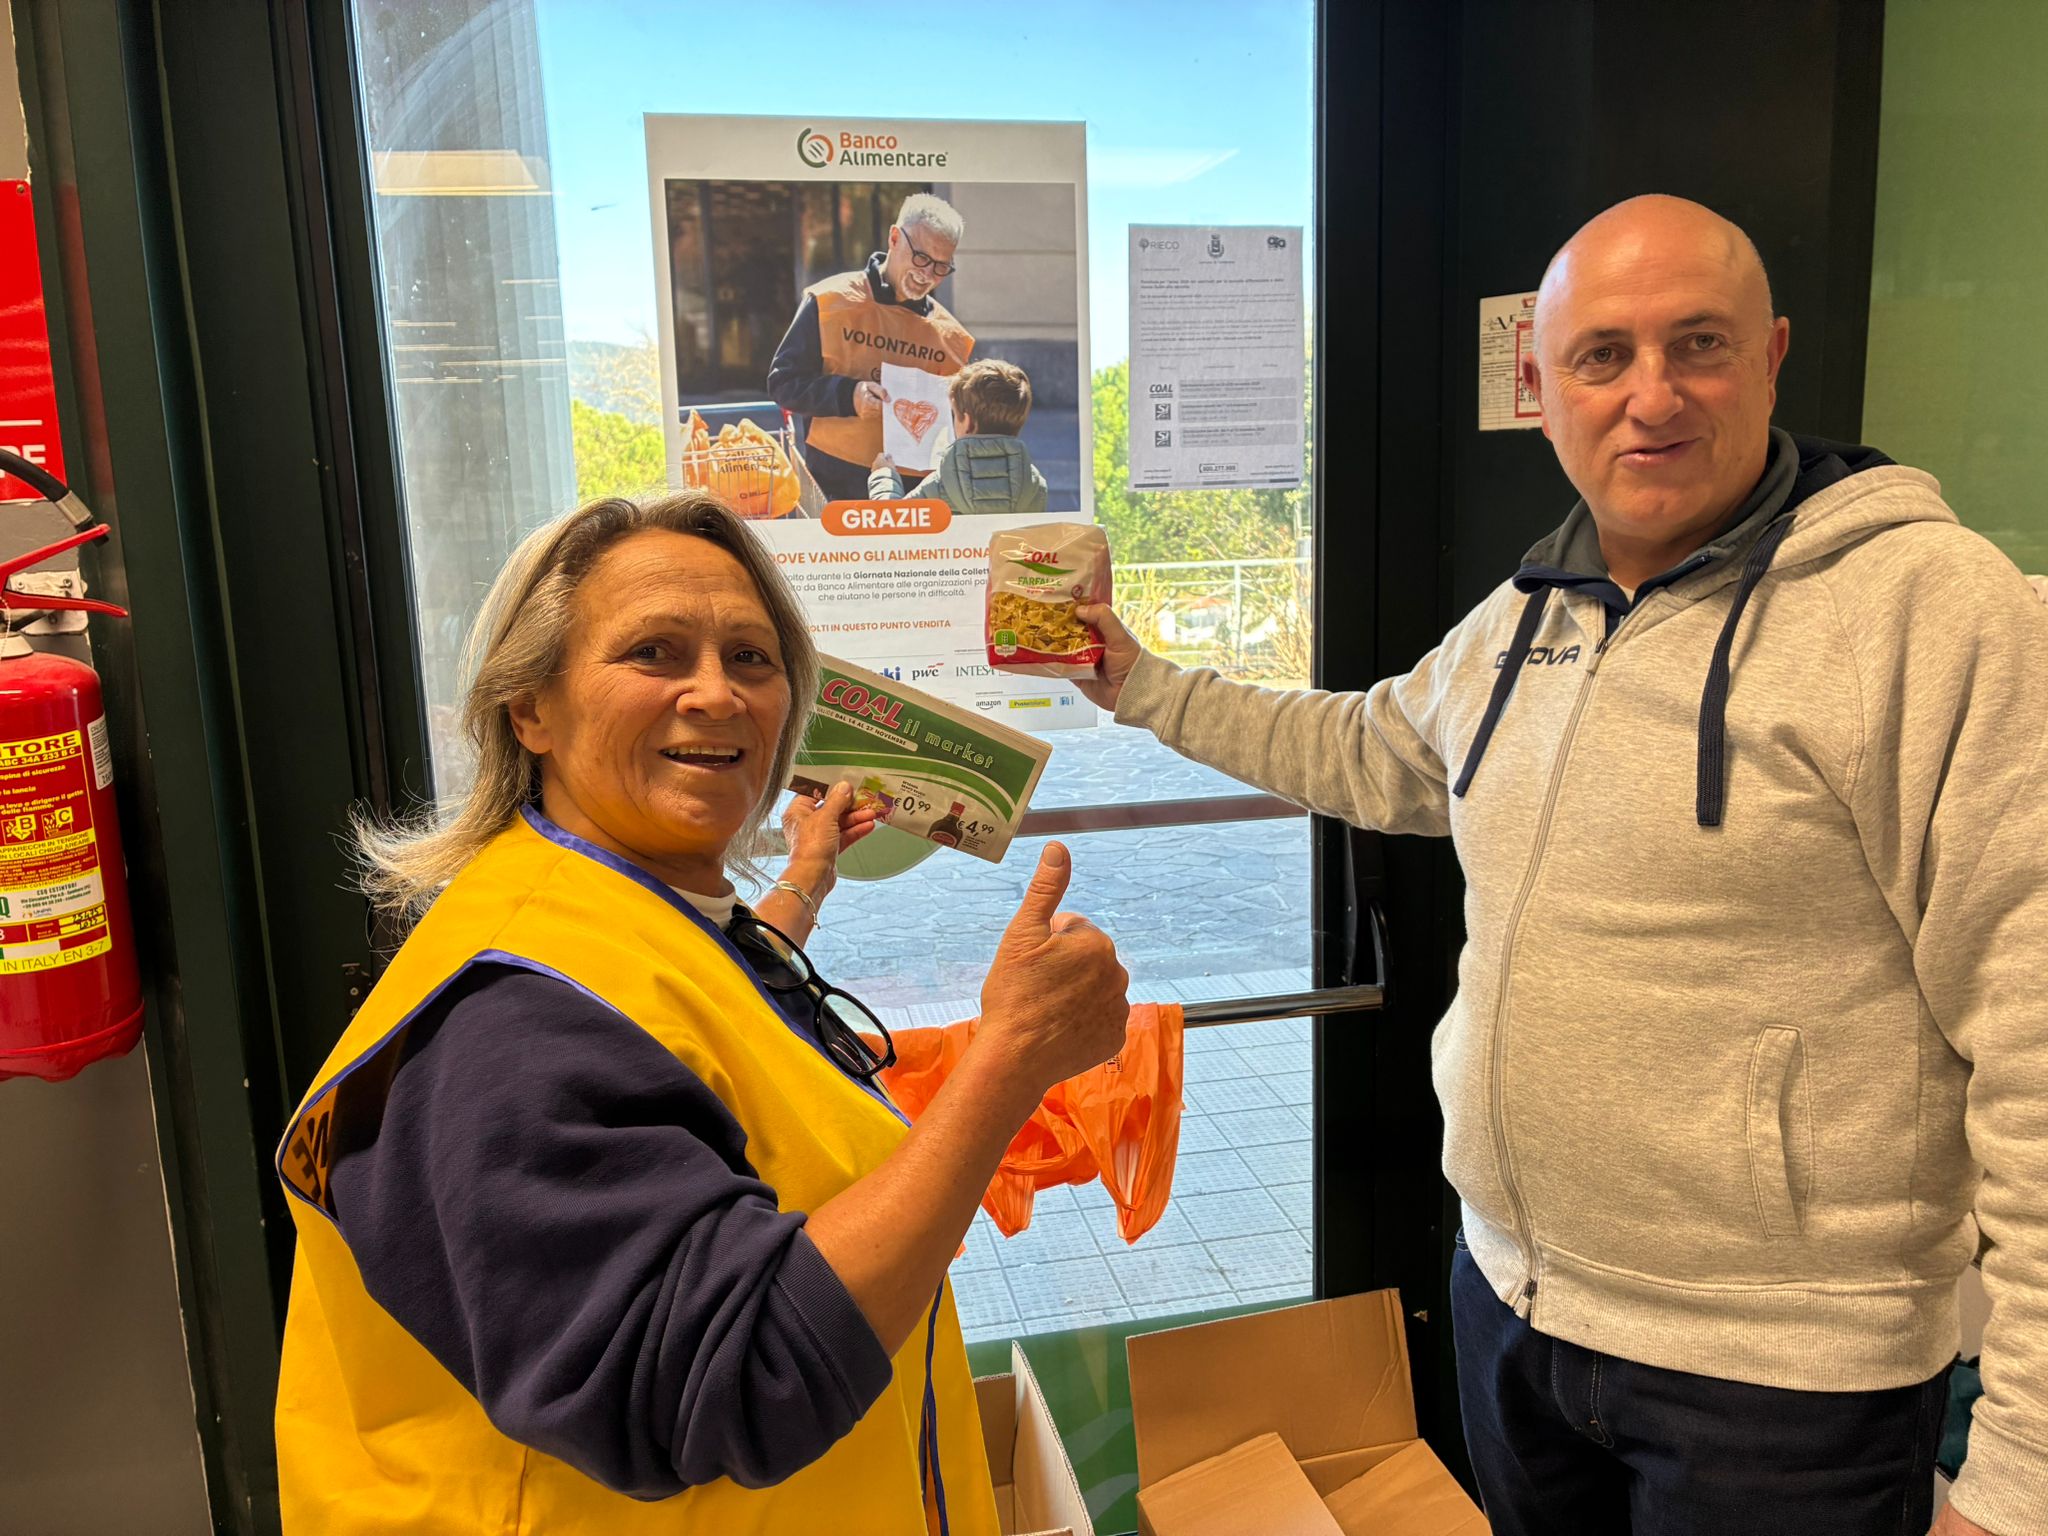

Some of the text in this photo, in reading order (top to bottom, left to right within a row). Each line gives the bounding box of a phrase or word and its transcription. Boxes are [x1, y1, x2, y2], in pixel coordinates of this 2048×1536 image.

[840, 132, 898, 149] Banco
[839, 150, 948, 167] Alimentare
[842, 328, 946, 363] VOLONTARIO
[1149, 384, 1173, 393] COAL
[841, 507, 931, 529] GRAZIE
[808, 552, 860, 563] VANNO
[864, 551, 885, 562] GLI
[888, 549, 949, 560] ALIMENTI
[806, 572, 841, 581] durante
[843, 571, 851, 580] la
[853, 570, 892, 579] Giornata
[894, 569, 937, 578] Nazionale
[939, 568, 960, 577] della
[804, 583, 815, 592] da
[818, 583, 845, 591] Banco
[848, 581, 894, 590] Alimentare
[896, 579, 912, 588] alle
[913, 577, 972, 590] organizzazioni
[818, 593, 834, 601] che
[837, 592, 870, 601] aiutano
[872, 591, 880, 599] le
[882, 591, 916, 601] persone
[918, 590, 926, 598] in
[831, 624, 840, 632] IN
[842, 622, 878, 632] QUESTO
[880, 621, 911, 630] PUNTO
[913, 620, 951, 629] VENDITA
[912, 667, 939, 681] pwc
[821, 677, 904, 730] COAL
[976, 700, 1001, 708] amazon
[834, 713, 846, 722] DAL
[857, 721, 865, 729] AL
[875, 728, 907, 747] NOVEMBRE
[0, 734, 76, 757] TORE
[903, 719, 994, 769] il market
[22, 755, 40, 765] 34A
[42, 750, 59, 761] 233
[20, 817, 33, 830] B
[58, 809, 71, 823] C
[48, 839, 55, 847] IN
[9, 848, 38, 859] LOCALI
[39, 844, 63, 856] CHIUSI
[4, 961, 17, 971] IN
[22, 954, 60, 969] ITALY
[64, 948, 82, 962] EN
